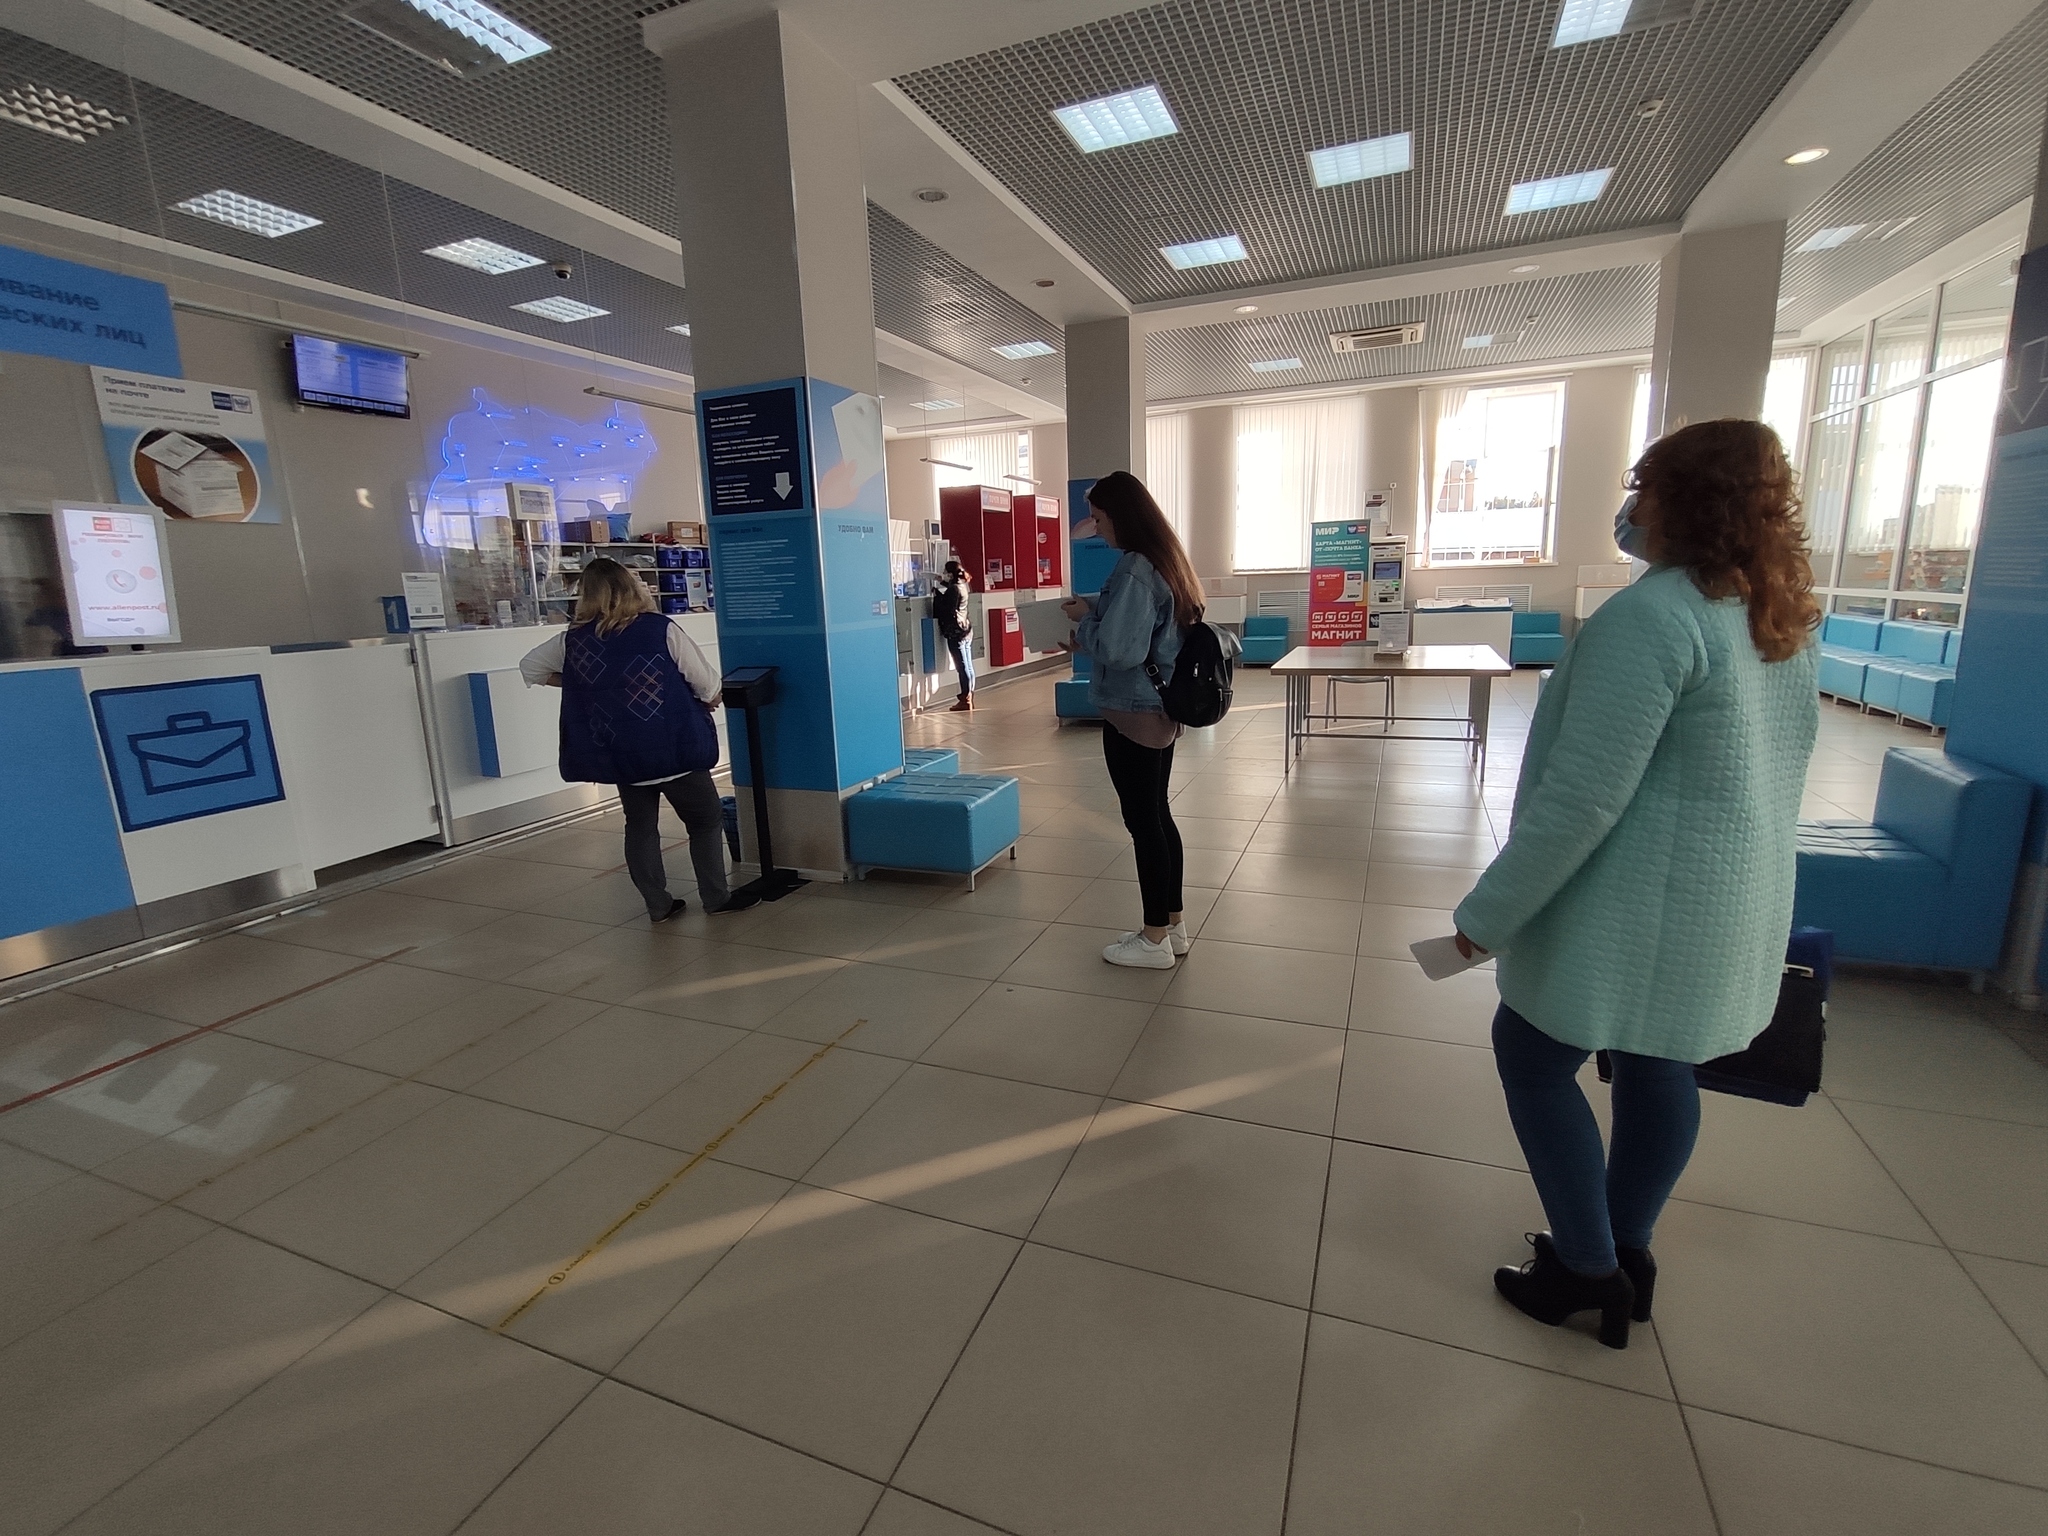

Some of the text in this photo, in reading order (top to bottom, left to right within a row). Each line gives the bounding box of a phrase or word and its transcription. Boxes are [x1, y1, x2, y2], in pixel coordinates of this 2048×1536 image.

[95, 324, 147, 349] лиц
[138, 381, 186, 394] платежей
[120, 389, 150, 399] почте
[838, 524, 861, 533] УДОБНО
[1315, 526, 1340, 536] МИР
[387, 600, 400, 630] 1
[1311, 630, 1362, 640] МАГНИТ
